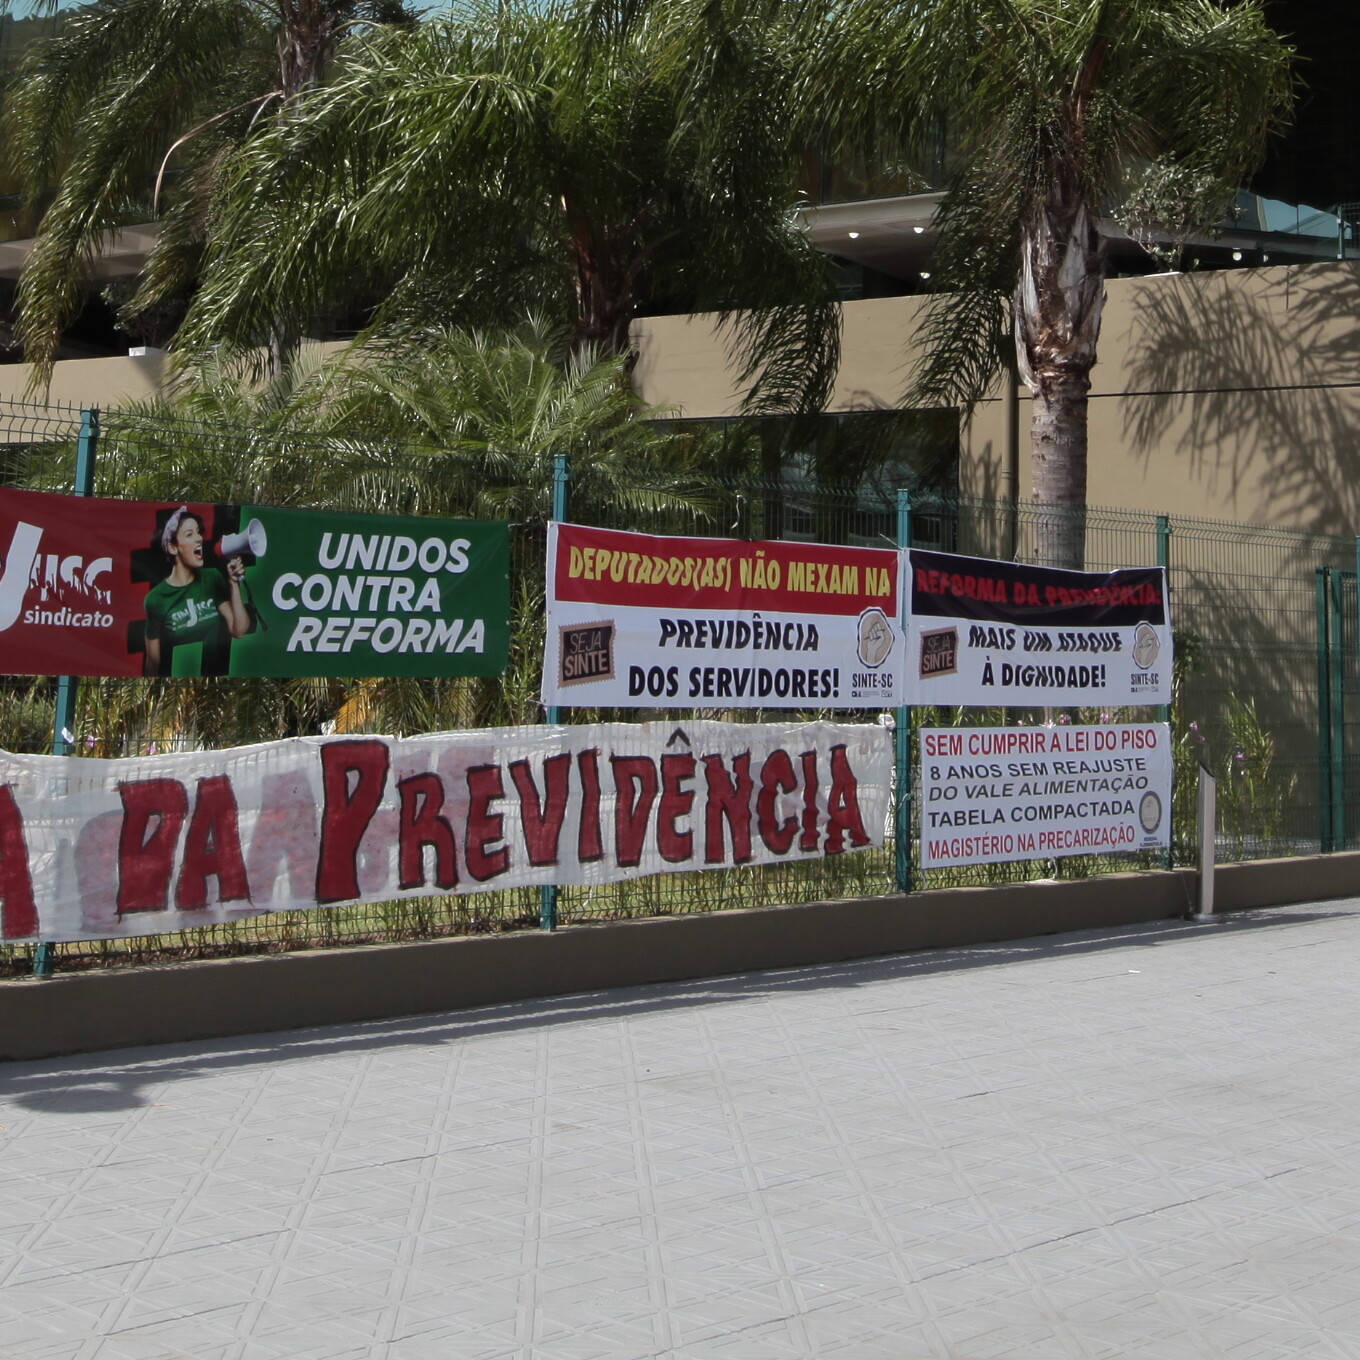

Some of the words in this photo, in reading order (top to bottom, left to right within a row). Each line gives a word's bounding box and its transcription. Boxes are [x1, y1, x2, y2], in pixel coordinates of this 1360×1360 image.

[318, 532, 471, 574] UNIDOS
[739, 550, 781, 590] NÃO
[787, 561, 859, 596] MEXAM
[865, 567, 890, 597] NA
[272, 572, 441, 613] CONTRA
[1014, 581, 1041, 606] DA
[24, 605, 114, 628] sindicato
[286, 616, 485, 654] REFORMA
[569, 631, 603, 652] SEJA
[658, 613, 819, 652] PREVIDÊNCIA
[926, 635, 952, 654] SEJA
[968, 625, 1016, 651] MAIS
[1023, 630, 1053, 652] UM
[1056, 632, 1123, 654] ATAQUE
[564, 649, 608, 678] SINTE
[923, 649, 954, 672] SINTE
[981, 656, 995, 686] À
[1002, 663, 1107, 688] DIGNIDADE!
[629, 665, 679, 697] DOS
[689, 667, 839, 699] SERVIDORES!
[852, 673, 893, 689] SINTE-SC
[926, 734, 963, 756] SEM
[969, 732, 1046, 755] CUMPRIR
[1050, 732, 1062, 753] A
[1066, 731, 1089, 752] LEI
[1095, 730, 1117, 751] DO
[1121, 729, 1157, 750] PISO
[930, 766, 940, 781] 8
[947, 764, 1003, 780] ANOS
[1009, 761, 1049, 777] SEM
[1053, 757, 1146, 775] REAJUSTE
[929, 786, 958, 801] DO
[965, 782, 1014, 800] VALE
[1018, 774, 1149, 797] ALIMENTAÇÃO
[116, 773, 254, 921] DA
[314, 727, 872, 906] PREVIDÊNCIA
[928, 808, 1005, 828] TABELA
[1010, 799, 1135, 823] COMPACTADA
[929, 831, 1013, 860] MAGISTÉRIO
[1018, 834, 1036, 853] NA
[1040, 821, 1136, 850] PRECARIZAÇÃO
